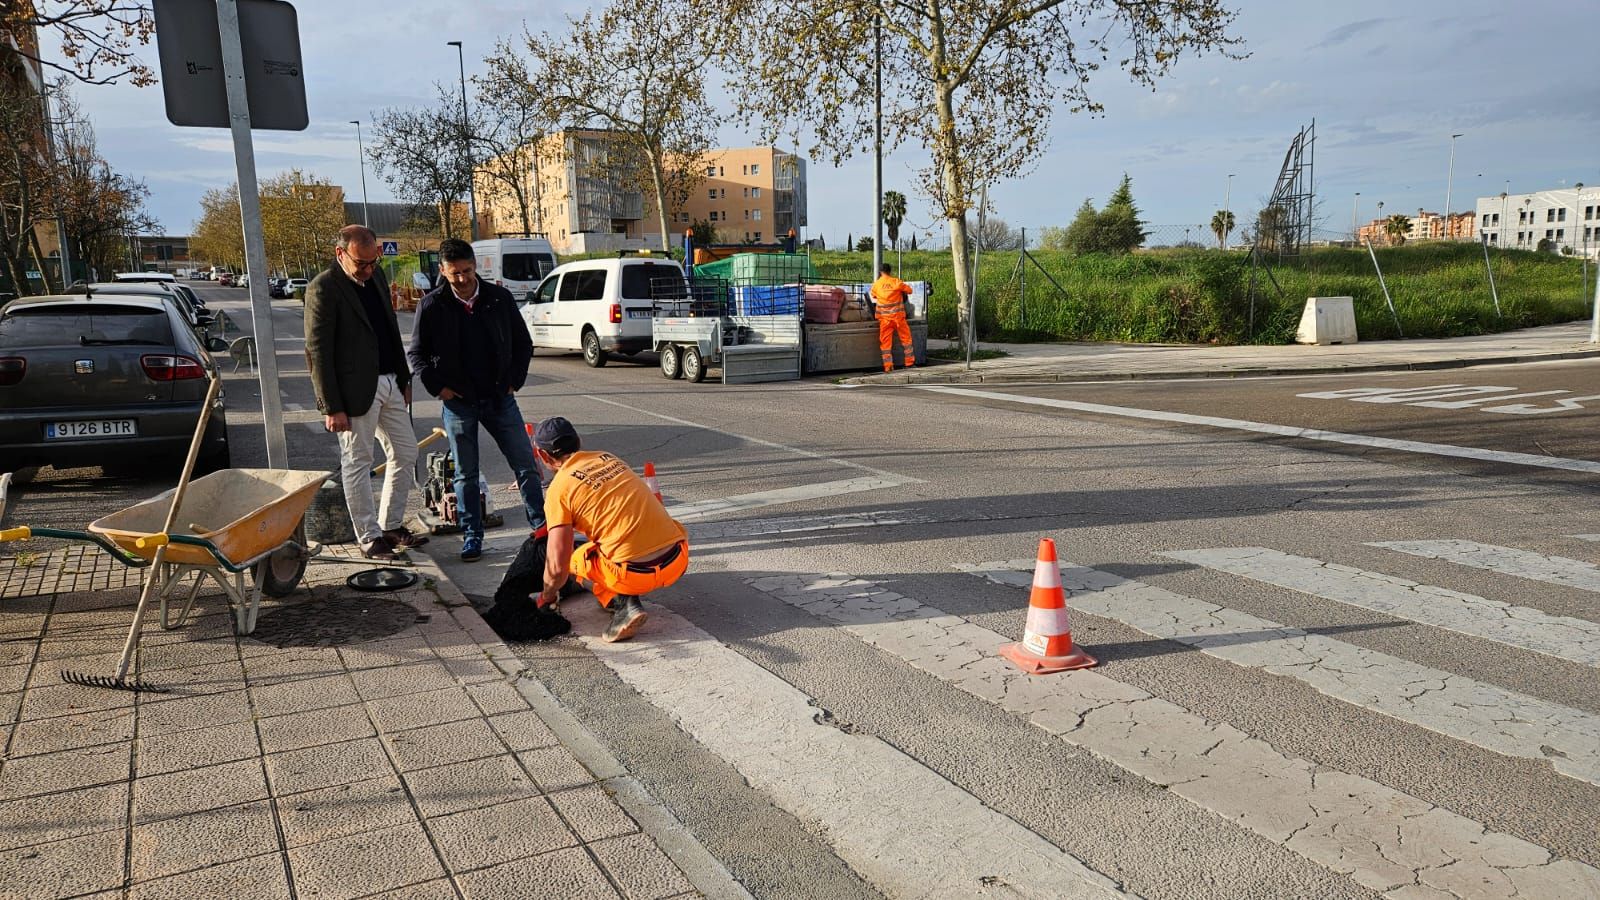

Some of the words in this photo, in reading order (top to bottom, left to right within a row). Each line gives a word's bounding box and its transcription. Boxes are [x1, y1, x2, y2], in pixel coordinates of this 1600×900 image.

[1296, 384, 1600, 415] STOP
[58, 422, 98, 436] 9126
[102, 421, 131, 434] BTR
